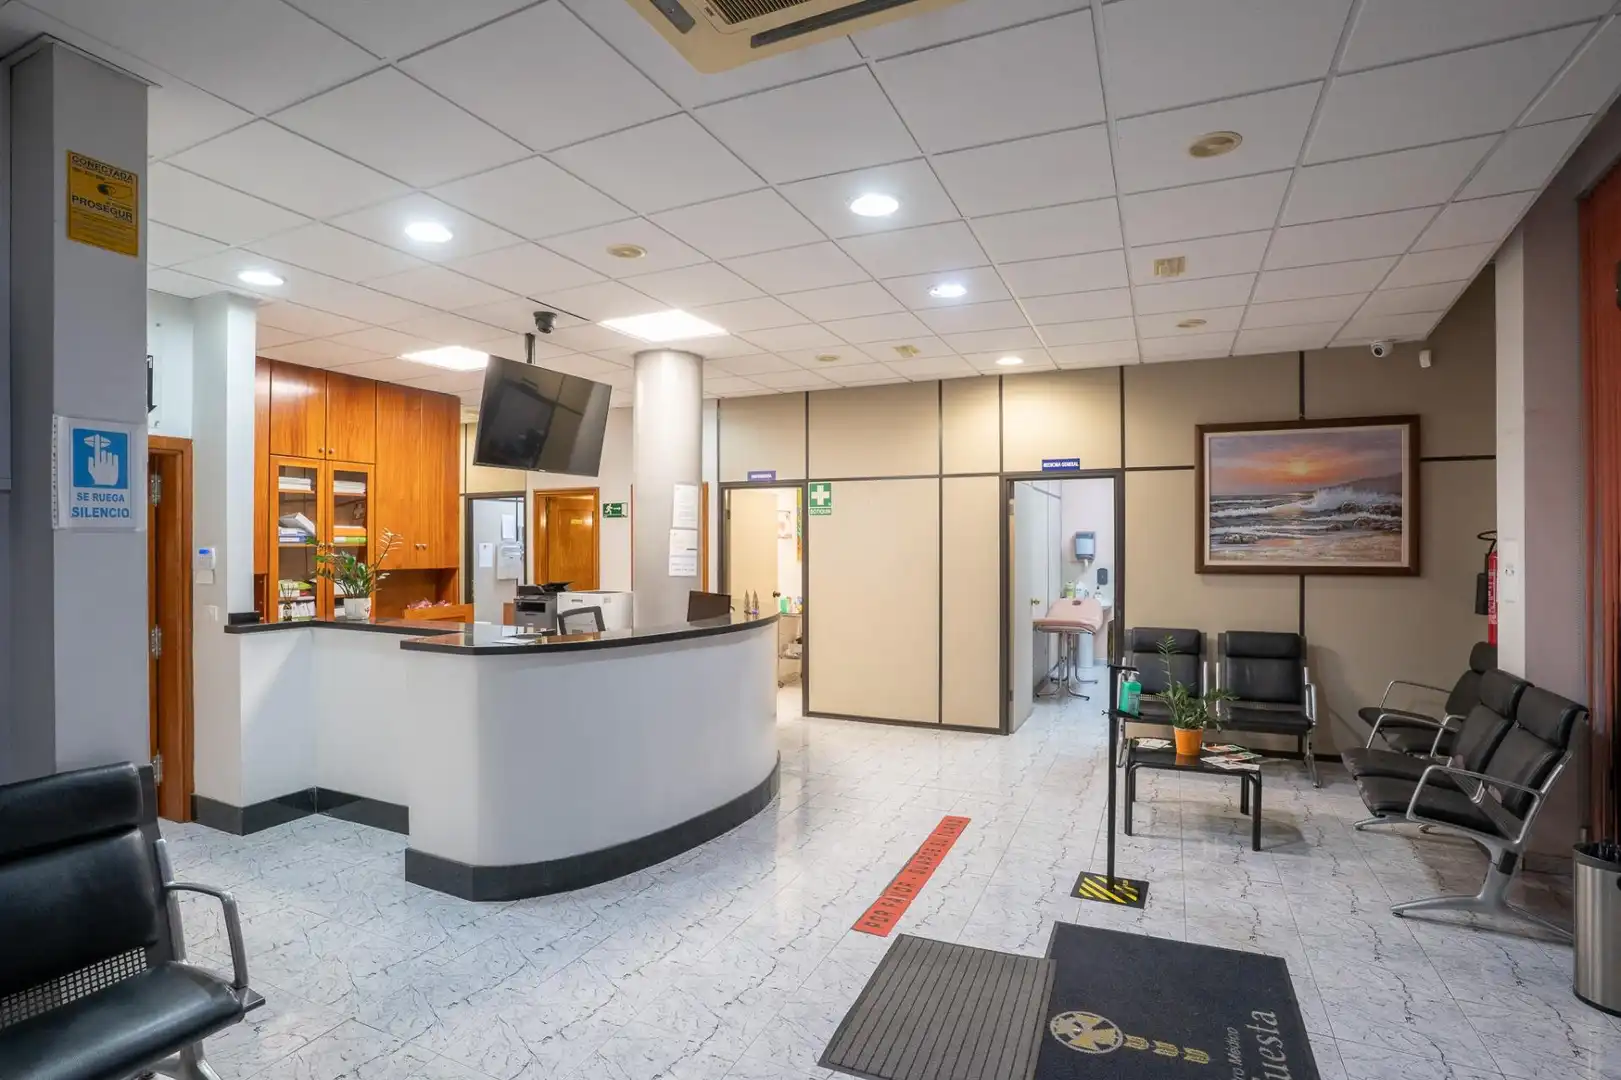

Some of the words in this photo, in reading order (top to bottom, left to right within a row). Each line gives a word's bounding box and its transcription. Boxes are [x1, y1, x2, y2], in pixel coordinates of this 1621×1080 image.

[71, 155, 133, 181] CONECTADA
[71, 195, 133, 221] PROSEGUR
[76, 492, 90, 501] SE
[92, 493, 125, 502] RUEGA
[71, 506, 130, 518] SILENCIO
